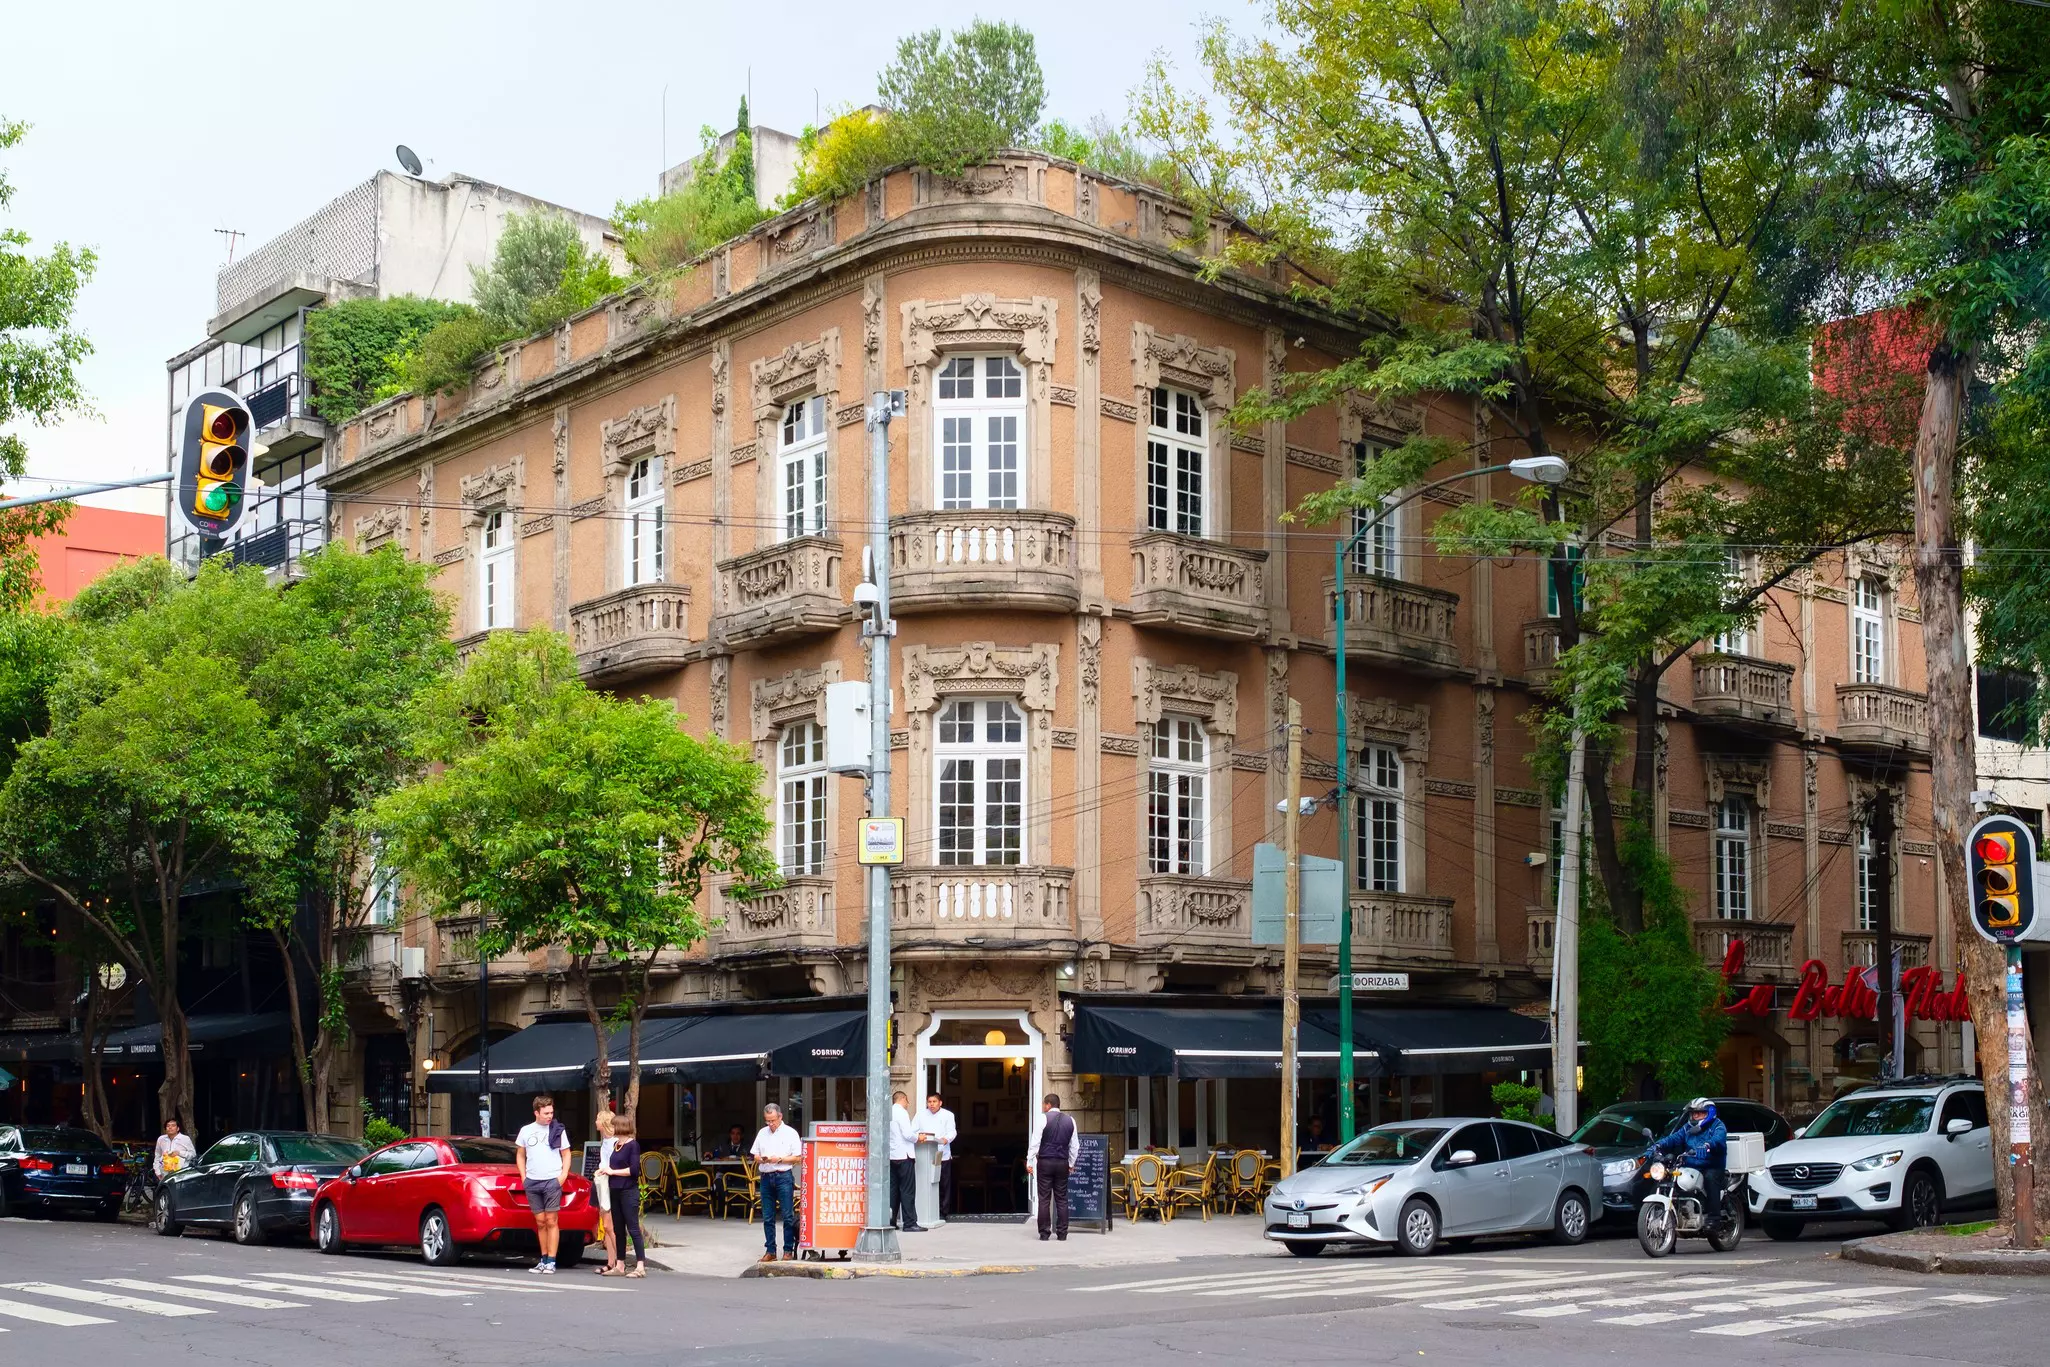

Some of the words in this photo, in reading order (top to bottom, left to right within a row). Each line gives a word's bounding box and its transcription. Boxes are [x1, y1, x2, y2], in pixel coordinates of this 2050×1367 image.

[1361, 977, 1401, 987] ORIZABA
[130, 1045, 156, 1053] LIMANTOUR
[811, 1048, 844, 1056] SOBRINOS
[1106, 1046, 1137, 1054] SOBRINOS
[817, 1157, 838, 1169] NOS
[820, 1202, 861, 1213] SANTA
[820, 1213, 841, 1223] SAN
